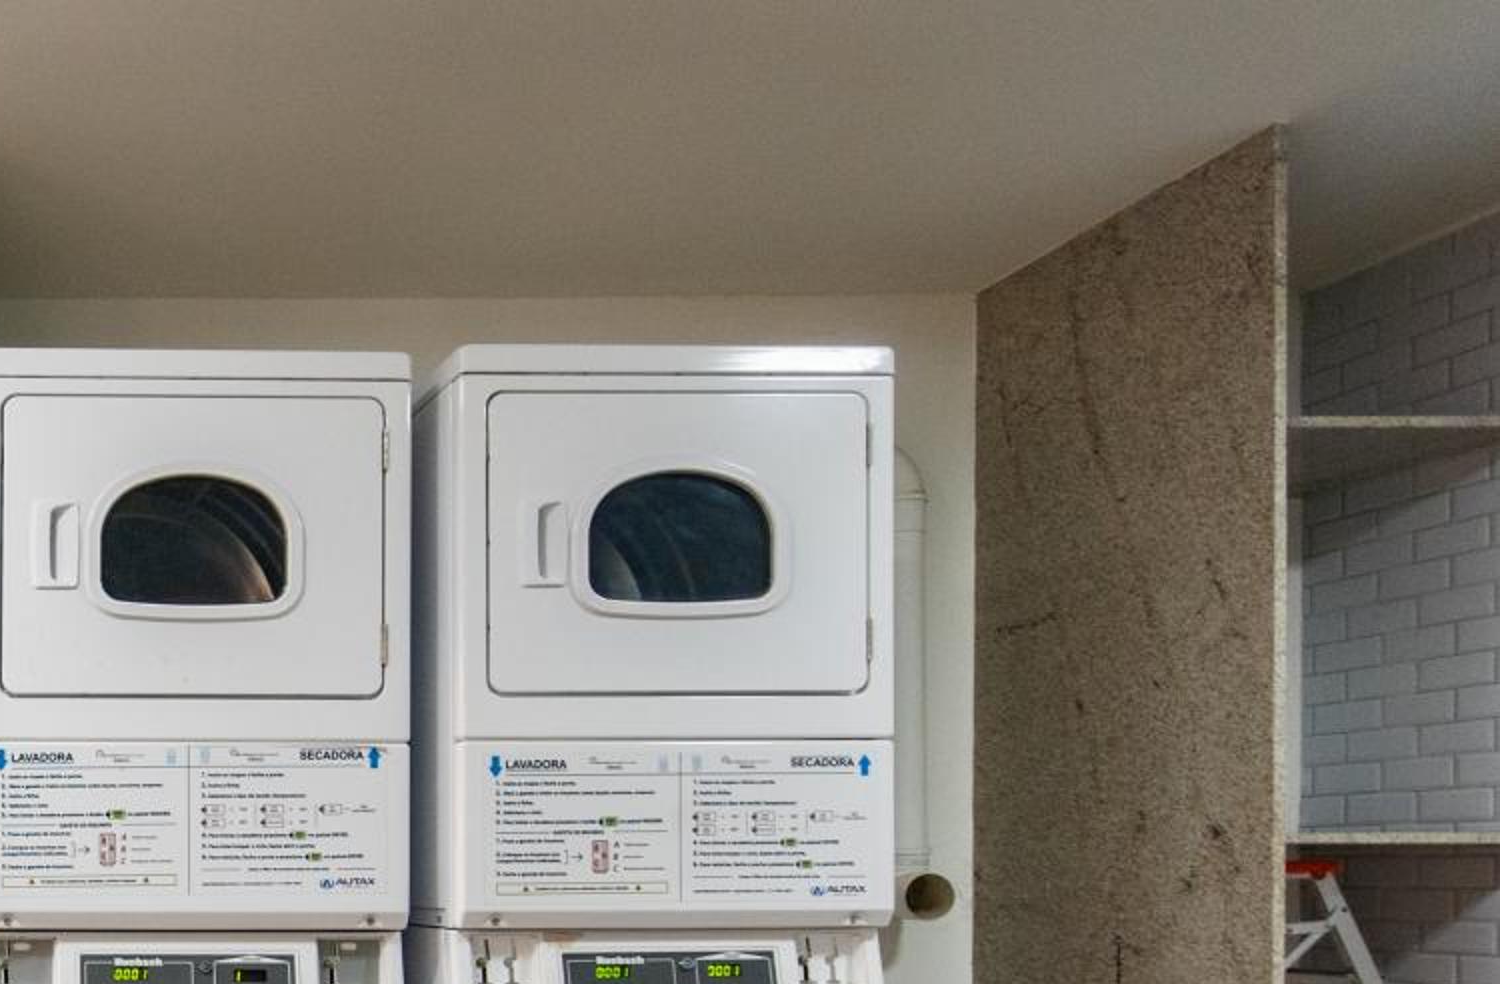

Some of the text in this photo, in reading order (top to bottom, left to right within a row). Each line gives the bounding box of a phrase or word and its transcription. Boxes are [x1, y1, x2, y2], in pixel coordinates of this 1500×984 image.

[11, 752, 75, 764] LAVADORA
[299, 750, 364, 761] SECADORA
[505, 759, 567, 770] LAVADORA
[790, 755, 856, 768] SECADORA
